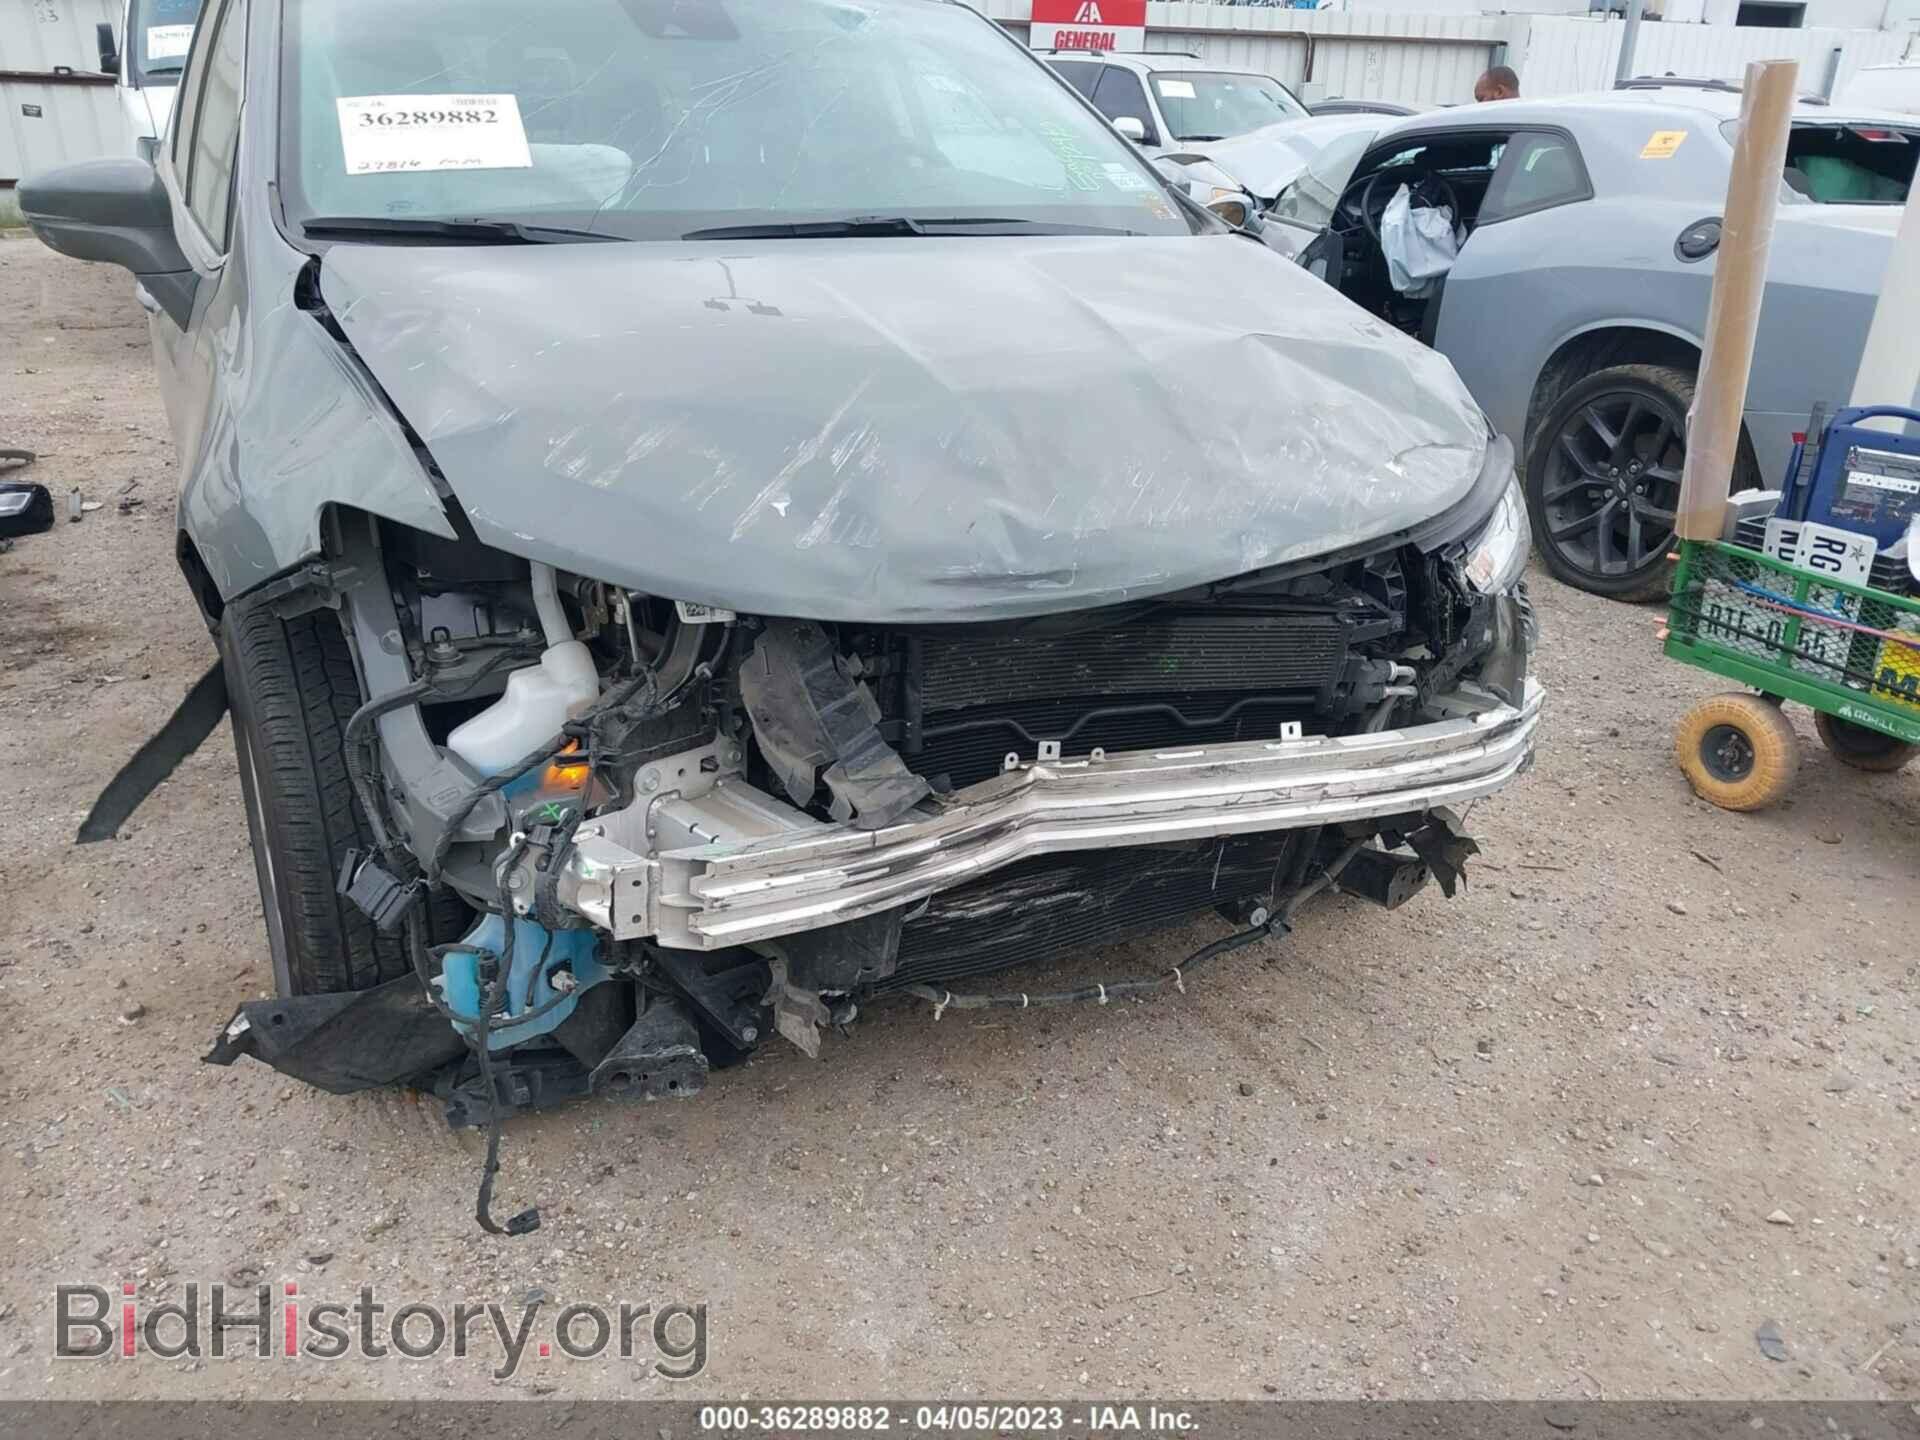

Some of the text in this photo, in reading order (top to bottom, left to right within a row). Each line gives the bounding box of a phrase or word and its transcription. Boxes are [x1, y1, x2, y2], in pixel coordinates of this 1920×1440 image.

[1054, 29, 1116, 52] GENERAL
[359, 109, 499, 128] 36289882
[1808, 535, 1847, 573] RG
